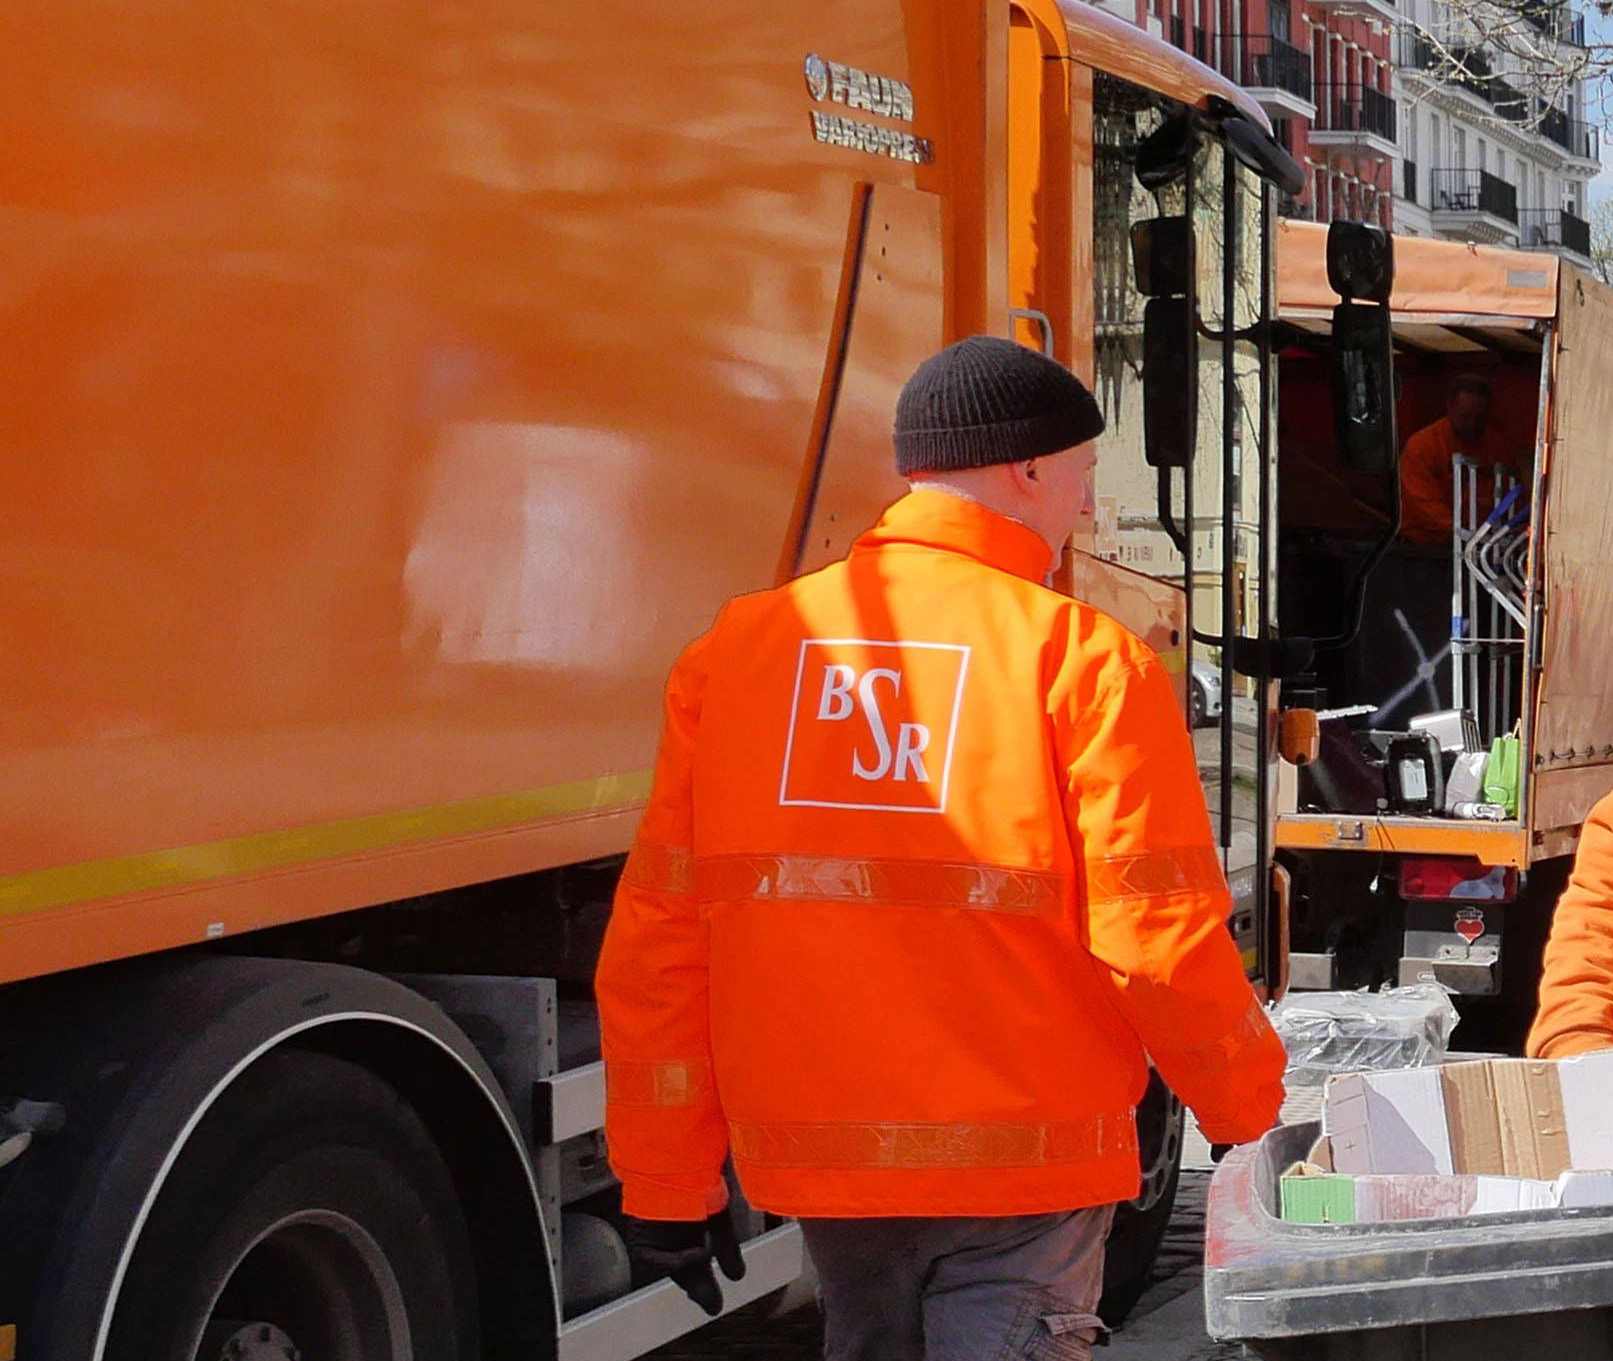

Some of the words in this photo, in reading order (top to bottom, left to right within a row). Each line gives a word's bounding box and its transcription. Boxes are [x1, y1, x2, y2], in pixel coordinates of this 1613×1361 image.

[827, 61, 913, 122] FAUN
[811, 110, 935, 164] VARIOPRESS
[816, 663, 931, 784] BSR
